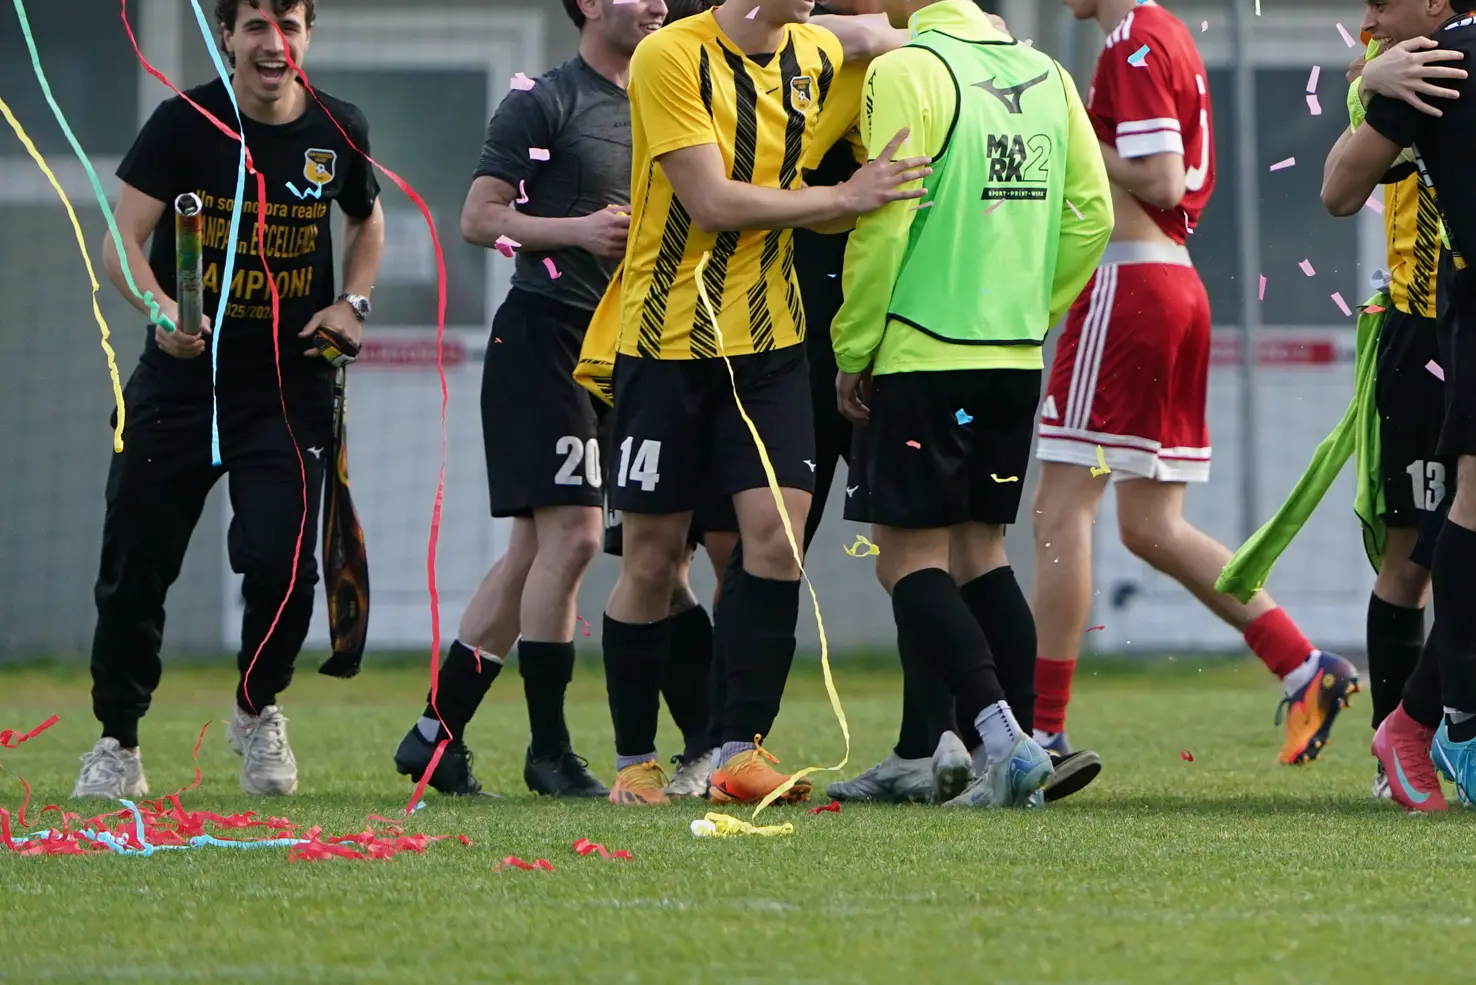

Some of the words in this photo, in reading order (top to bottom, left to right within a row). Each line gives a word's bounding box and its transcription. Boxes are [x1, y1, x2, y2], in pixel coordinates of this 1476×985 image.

[202, 262, 313, 301] AMPIONI
[554, 435, 602, 489] 20
[617, 436, 662, 492] 14
[1406, 459, 1446, 512] 13
